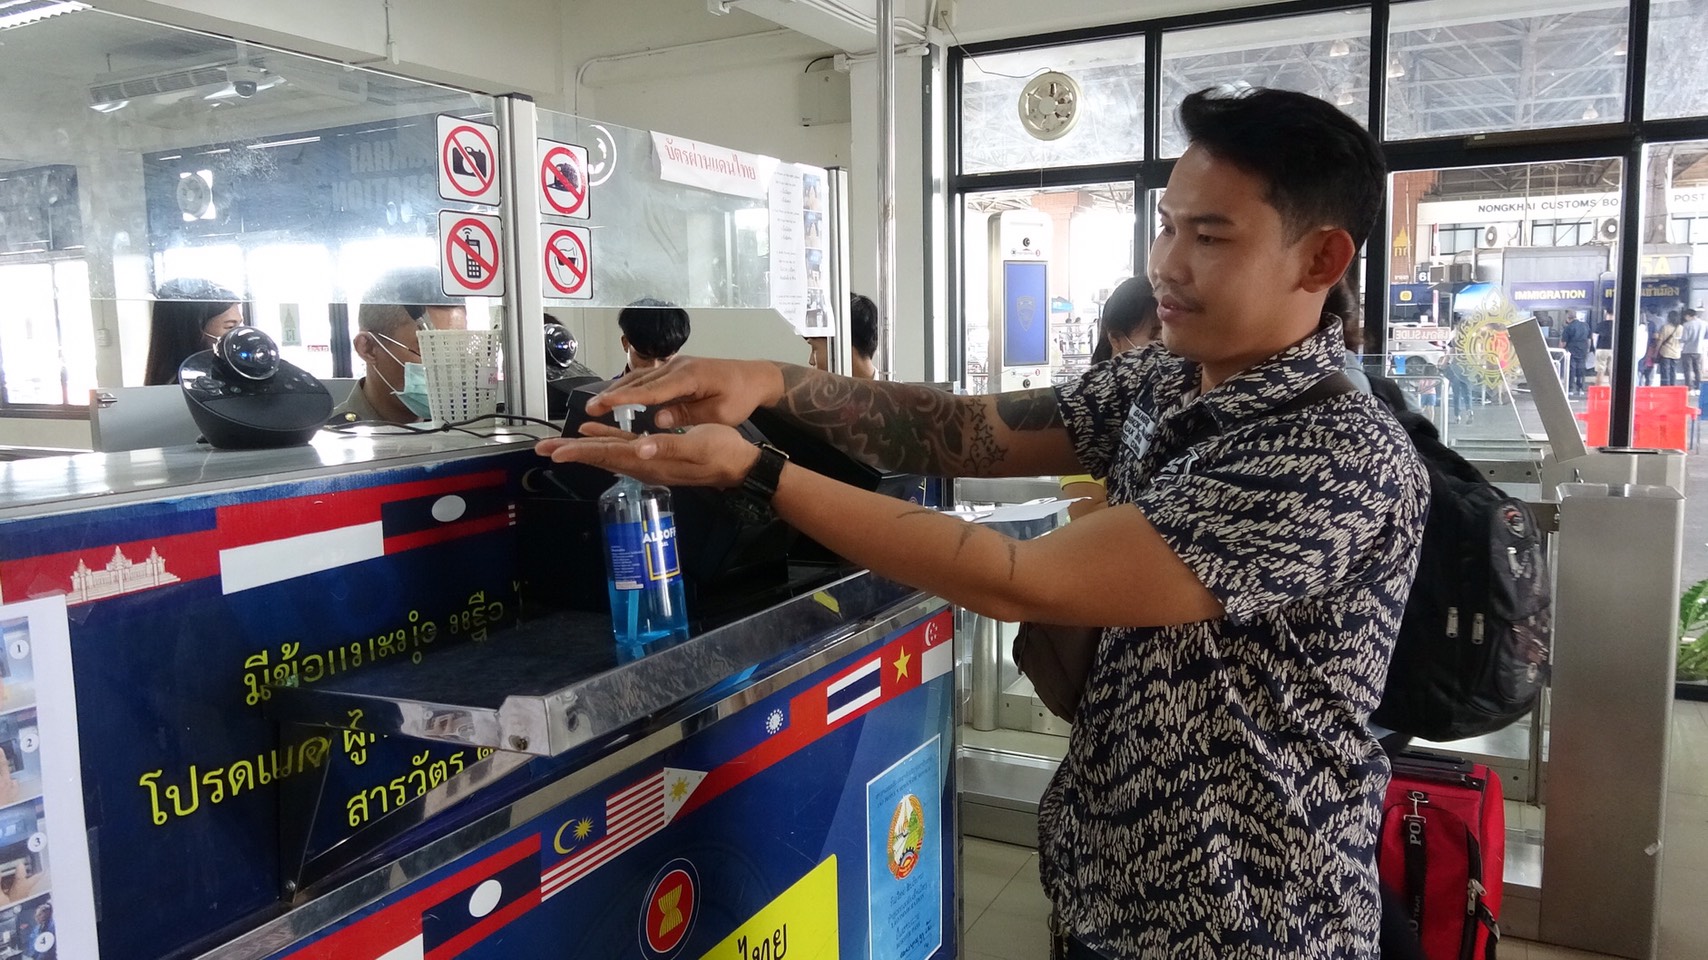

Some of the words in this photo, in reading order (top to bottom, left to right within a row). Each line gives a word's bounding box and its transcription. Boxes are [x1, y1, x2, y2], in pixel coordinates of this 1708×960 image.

[1478, 203, 1536, 213] NONGKHAI
[1541, 199, 1597, 210] CUSTOMS
[1674, 193, 1705, 202] POST
[1418, 271, 1430, 282] 6
[1514, 289, 1586, 301] IMMIGRATION
[17, 644, 22, 653] 1
[27, 737, 33, 748] 2
[347, 750, 465, 827] สารวัตร
[34, 837, 41, 847] 3
[41, 936, 47, 946] 4
